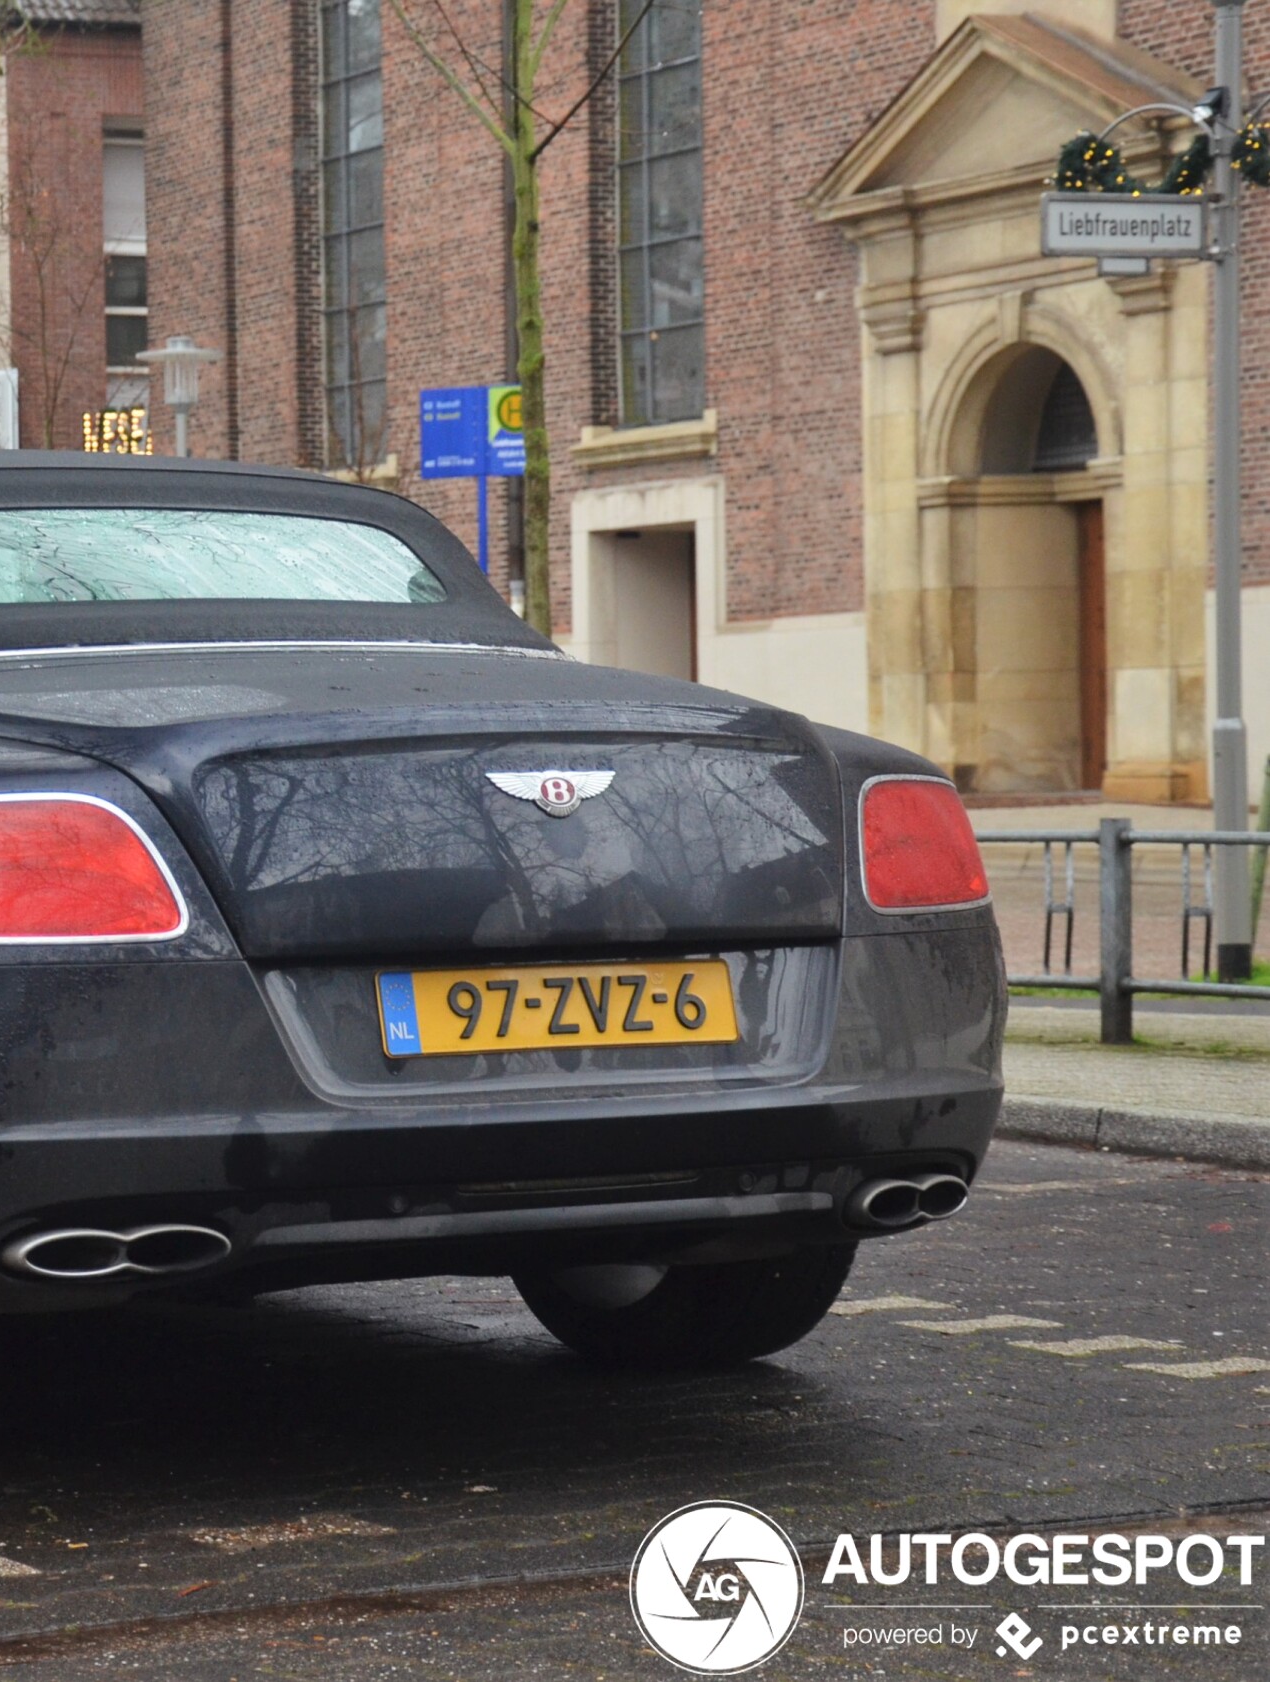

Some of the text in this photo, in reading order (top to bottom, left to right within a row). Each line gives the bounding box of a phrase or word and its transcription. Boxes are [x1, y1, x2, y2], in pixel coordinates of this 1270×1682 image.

[1059, 211, 1192, 243] Liebfrauenplatz
[447, 973, 707, 1040] 97-ZVZ-6
[389, 1022, 415, 1040] NL
